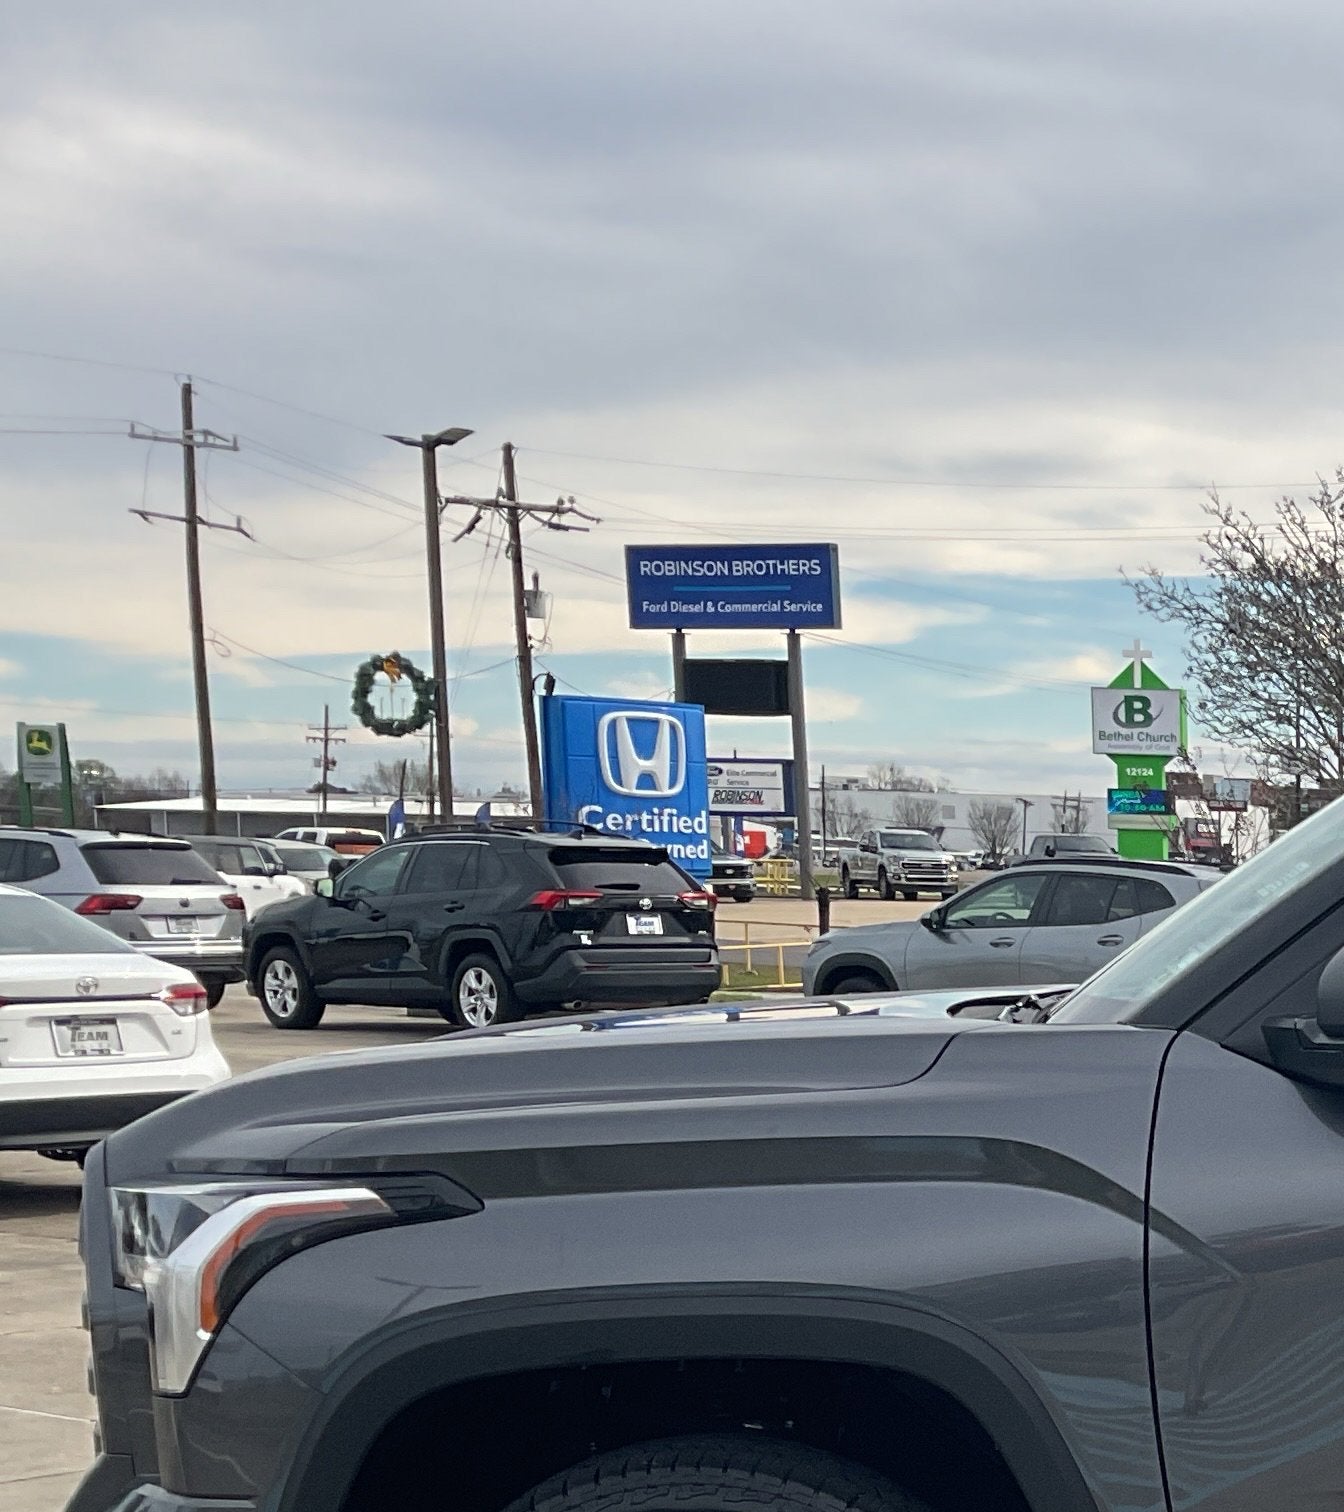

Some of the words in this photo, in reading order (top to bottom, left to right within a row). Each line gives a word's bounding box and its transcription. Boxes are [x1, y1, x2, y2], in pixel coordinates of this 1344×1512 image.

[639, 560, 729, 577] ROBINSON
[732, 559, 821, 576] BROTHERS
[643, 601, 668, 613] Ford
[670, 601, 704, 613] Diesel
[706, 601, 715, 613] &
[717, 600, 781, 613] Commercial
[783, 600, 823, 613] Service
[1098, 730, 1134, 741] Bethel
[1137, 732, 1177, 743] Church
[1126, 767, 1154, 777] 12124
[712, 789, 764, 802] ROBINSON
[578, 804, 708, 834] Certified
